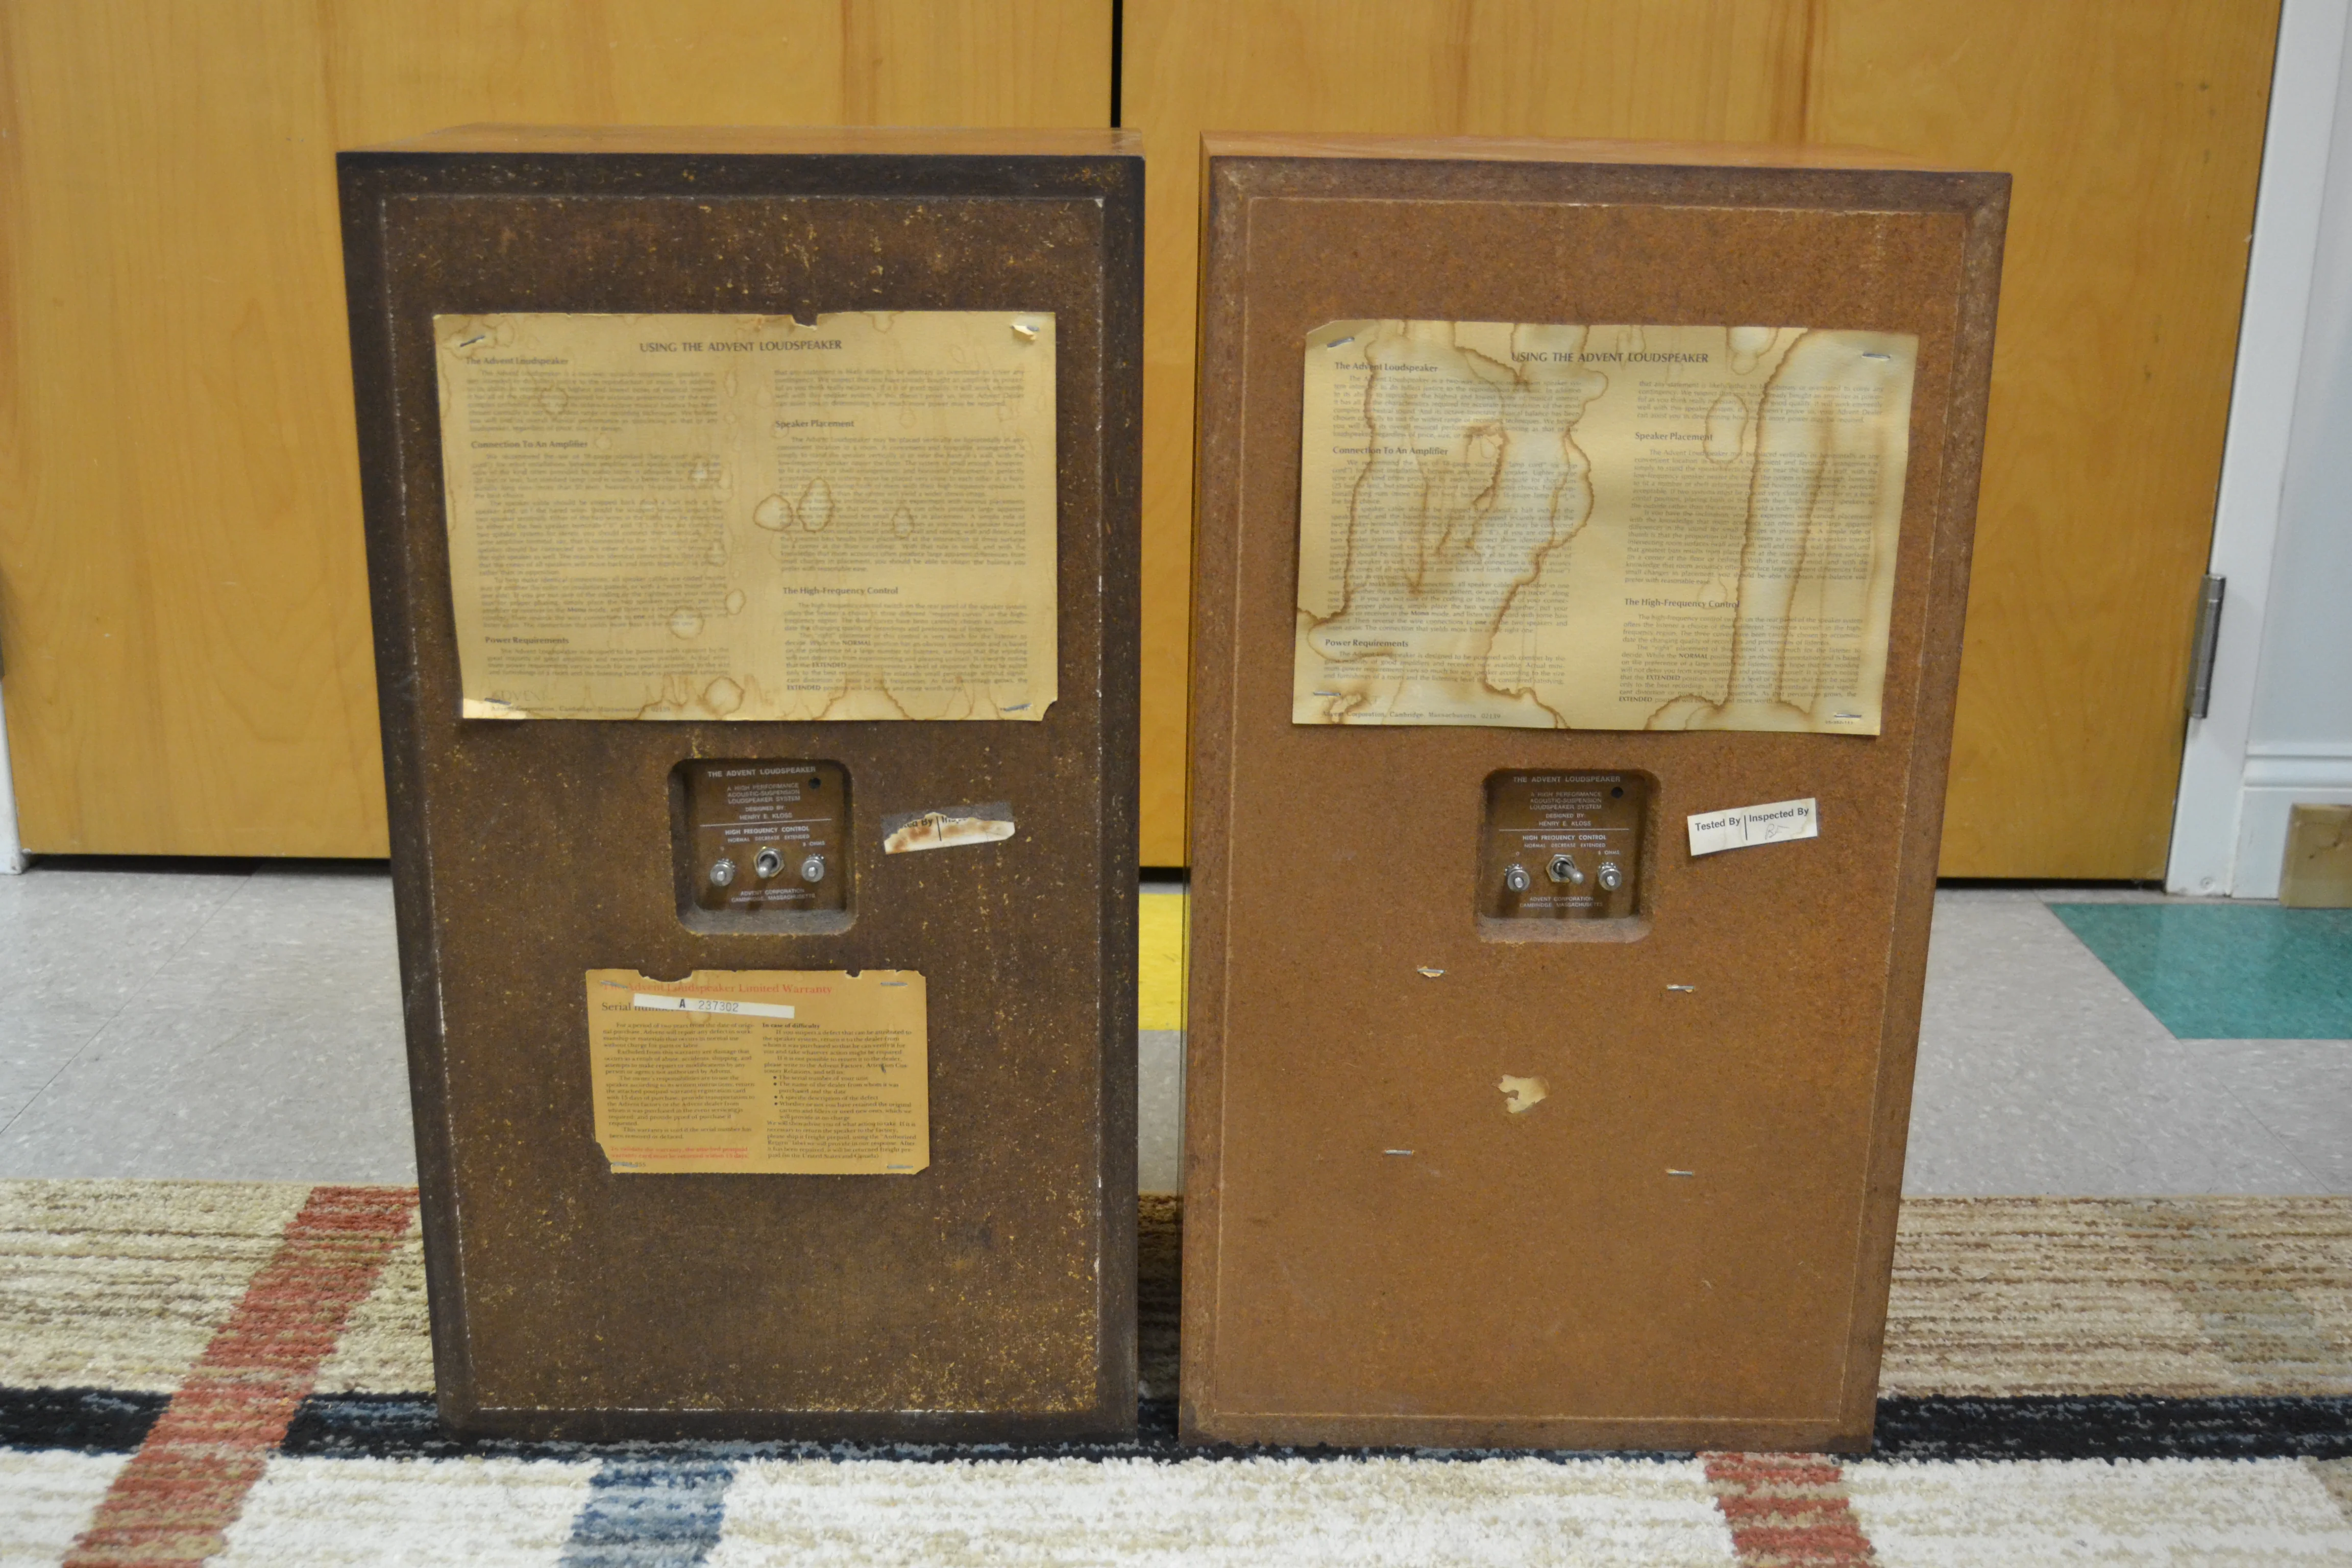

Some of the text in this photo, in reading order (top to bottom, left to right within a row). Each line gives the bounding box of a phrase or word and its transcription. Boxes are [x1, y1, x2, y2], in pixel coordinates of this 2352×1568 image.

[640, 339, 842, 352] USING THE ADVENT LOUDSPEAKER
[516, 357, 568, 365] Loudspeaker
[1511, 352, 1709, 363] USING THE ADVENT LOUDSPEAKER
[1353, 362, 1382, 371] Advent
[1384, 363, 1438, 373] Loudspeaker
[776, 420, 808, 428] Speaker
[1635, 432, 1713, 442] Speaker Placement
[471, 440, 520, 449] Connection
[549, 440, 588, 449] Amplifier
[1410, 447, 1449, 456] Amplifier
[800, 587, 865, 596] High-Frequency
[1641, 598, 1706, 608] High-Frequency
[513, 637, 570, 645] Requirements
[760, 766, 816, 775] LOUDSPEAKER
[1749, 807, 1809, 822] Inspected By
[1695, 817, 1741, 831] Tested By
[628, 983, 664, 991] Advent
[667, 983, 736, 994] Loudspeaker
[738, 983, 779, 993] Limited
[782, 984, 832, 994] Warranty
[601, 1002, 631, 1011] Serial
[679, 998, 739, 1012] A 237302
